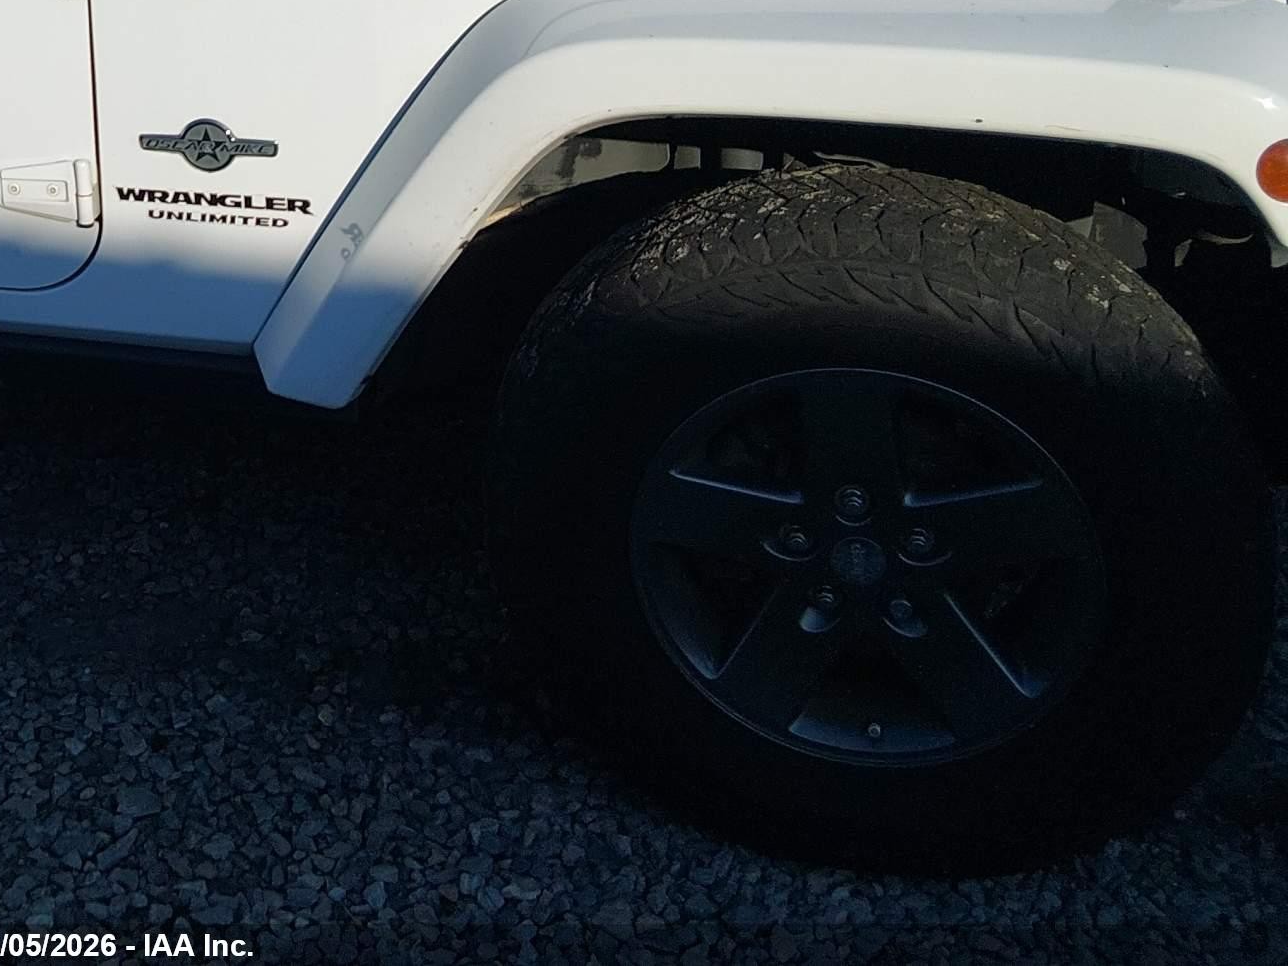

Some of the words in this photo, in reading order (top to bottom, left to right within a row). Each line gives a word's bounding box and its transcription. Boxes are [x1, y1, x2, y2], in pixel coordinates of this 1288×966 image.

[145, 137, 214, 152] OSCAR
[219, 142, 271, 154] MIKE
[115, 186, 313, 215] WRANGLER
[148, 209, 289, 228] UNLIMITED
